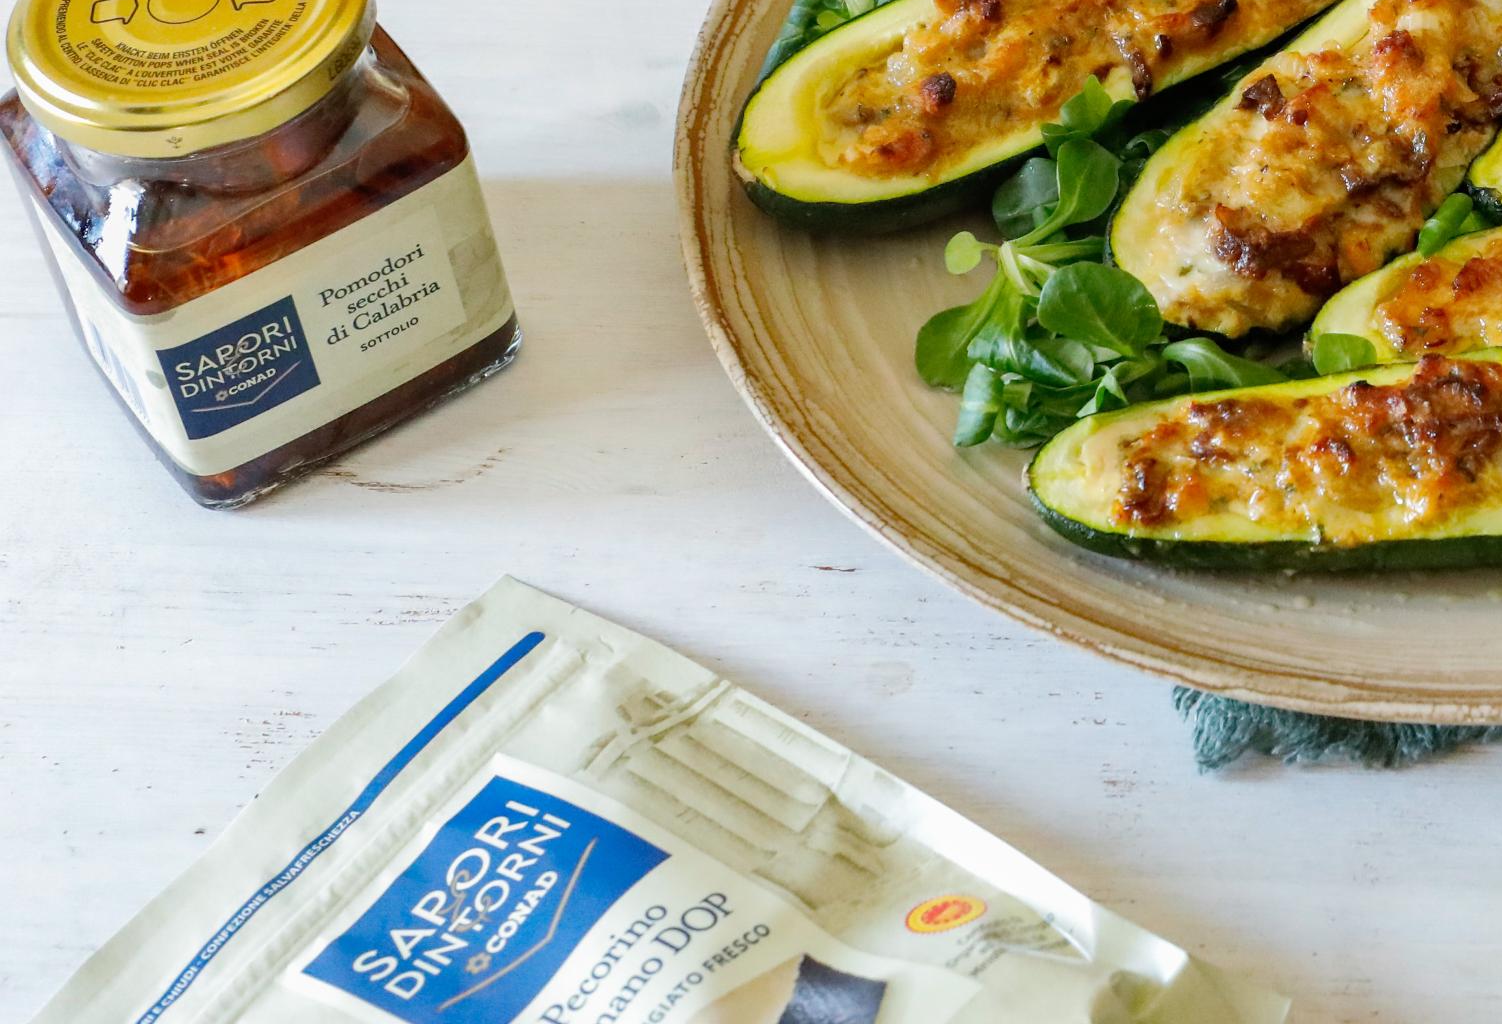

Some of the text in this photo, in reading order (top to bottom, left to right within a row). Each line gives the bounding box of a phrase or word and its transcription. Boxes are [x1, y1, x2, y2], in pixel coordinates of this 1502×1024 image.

[56, 0, 71, 34] PREMENDO
[289, 2, 305, 23] DELLA
[60, 42, 82, 64] CENTRO
[76, 42, 89, 51] LE
[200, 61, 220, 71] EST
[220, 48, 248, 64] VOTRE
[91, 18, 270, 68] SAFETY BUTTON POPS WHEN SEAL IS BROKEN
[115, 28, 244, 60] KNACKT BEIM ERSTEN ÖFFNEN
[193, 56, 251, 82] GARANTISCE
[318, 243, 425, 308] Pomodori
[347, 273, 409, 315] secchi
[326, 280, 441, 345] di Calabria
[360, 317, 419, 352] SOTTOLIO
[175, 316, 293, 381] SAPORI
[179, 336, 298, 399] DINTORNI
[228, 367, 276, 395] CONAD
[161, 811, 361, 1007] CHIUDI CONFEZIONE SALVAFRESCHEZZA
[352, 799, 541, 982] SAPORI
[384, 813, 572, 1001] DINTORNI
[486, 870, 559, 954] CONAD
[653, 892, 733, 956] DOP
[702, 924, 770, 973] FRESCO
[539, 904, 668, 1024] Pecorino
